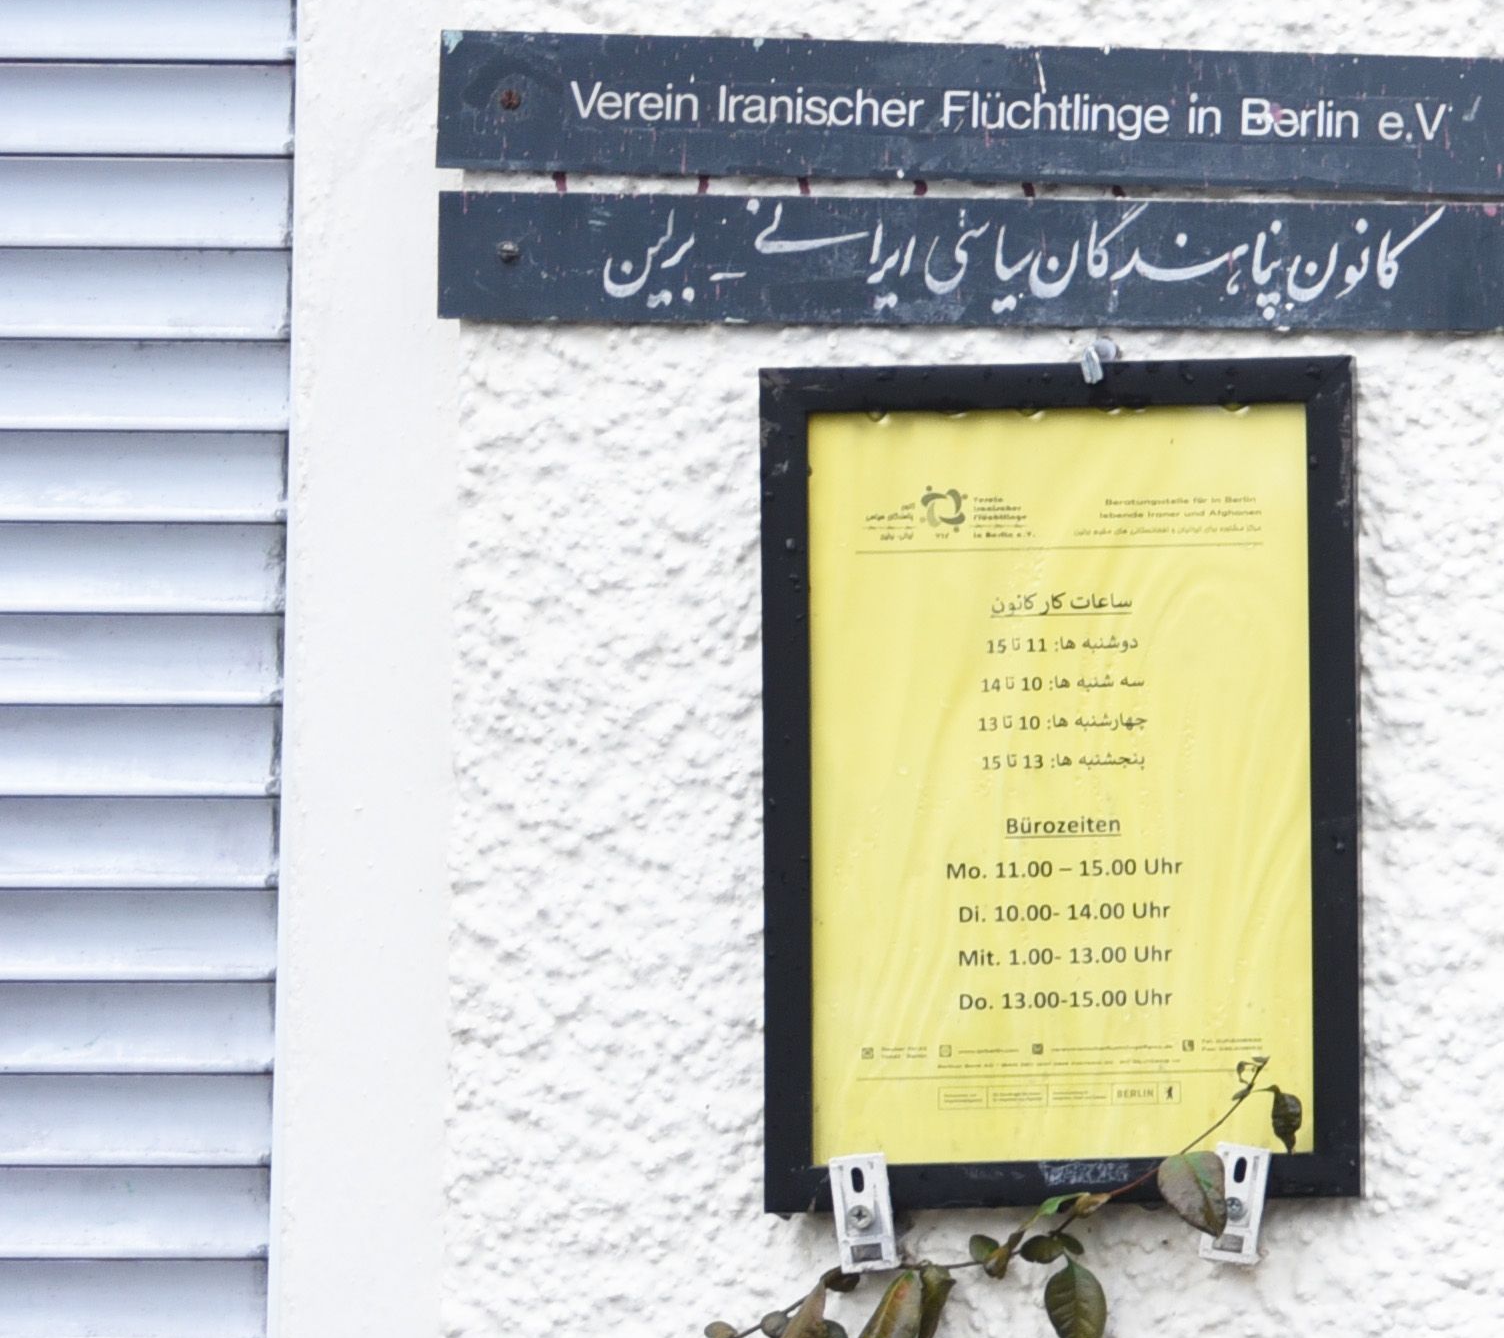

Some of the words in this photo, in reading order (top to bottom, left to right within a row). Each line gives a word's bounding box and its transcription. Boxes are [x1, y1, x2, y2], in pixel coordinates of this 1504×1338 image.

[570, 81, 698, 121] Verein
[718, 84, 925, 128] Iranischer
[942, 90, 1170, 141] Flüchtlinge
[1188, 92, 1222, 135] in
[1241, 97, 1359, 138] Berlin
[603, 208, 695, 309] برلین
[1286, 205, 1446, 301] کانون
[991, 592, 1037, 615] کانون
[1038, 592, 1066, 615] کار
[1070, 593, 1133, 609] ساعات
[987, 639, 1007, 654] 15
[1011, 637, 1021, 651] تا
[1027, 637, 1047, 652] 11
[1054, 636, 1076, 652] ها:
[1082, 635, 1138, 653] دوشنبه
[981, 678, 1001, 693] 14
[1005, 675, 1015, 690] تا
[1021, 676, 1043, 691] 10
[1049, 675, 1071, 691] ها:
[1077, 674, 1114, 692] شنبه
[1119, 675, 1145, 688] سه
[978, 717, 998, 732] 13
[1002, 715, 1012, 729] تا
[1019, 715, 1041, 731] 10
[1047, 714, 1068, 730] ها:
[982, 756, 1001, 770] 15
[1006, 754, 1017, 768] تا
[1023, 754, 1044, 769] 13
[1051, 753, 1072, 769] ها:
[1078, 752, 1146, 770] پنجشنبه
[1006, 815, 1121, 835] Bürozeiten
[946, 863, 987, 880] Mo.
[995, 860, 1053, 879] 11.00
[1079, 859, 1137, 877] 15.00
[1144, 857, 1183, 875] Uhr
[958, 906, 987, 923] Di.
[994, 904, 1060, 922] 10.00-
[1067, 902, 1125, 921] 14.00
[1132, 902, 1171, 919] Uhr
[958, 949, 1001, 967] Mit.
[1009, 947, 1061, 966] 1.00-
[1069, 946, 1127, 964] 13.00
[1134, 945, 1173, 962] Uhr
[958, 994, 994, 1010] Do.
[1002, 989, 1127, 1010] 13.00-15.00
[1134, 988, 1173, 1006] Uhr
[1116, 1089, 1154, 1099] BERLIN
